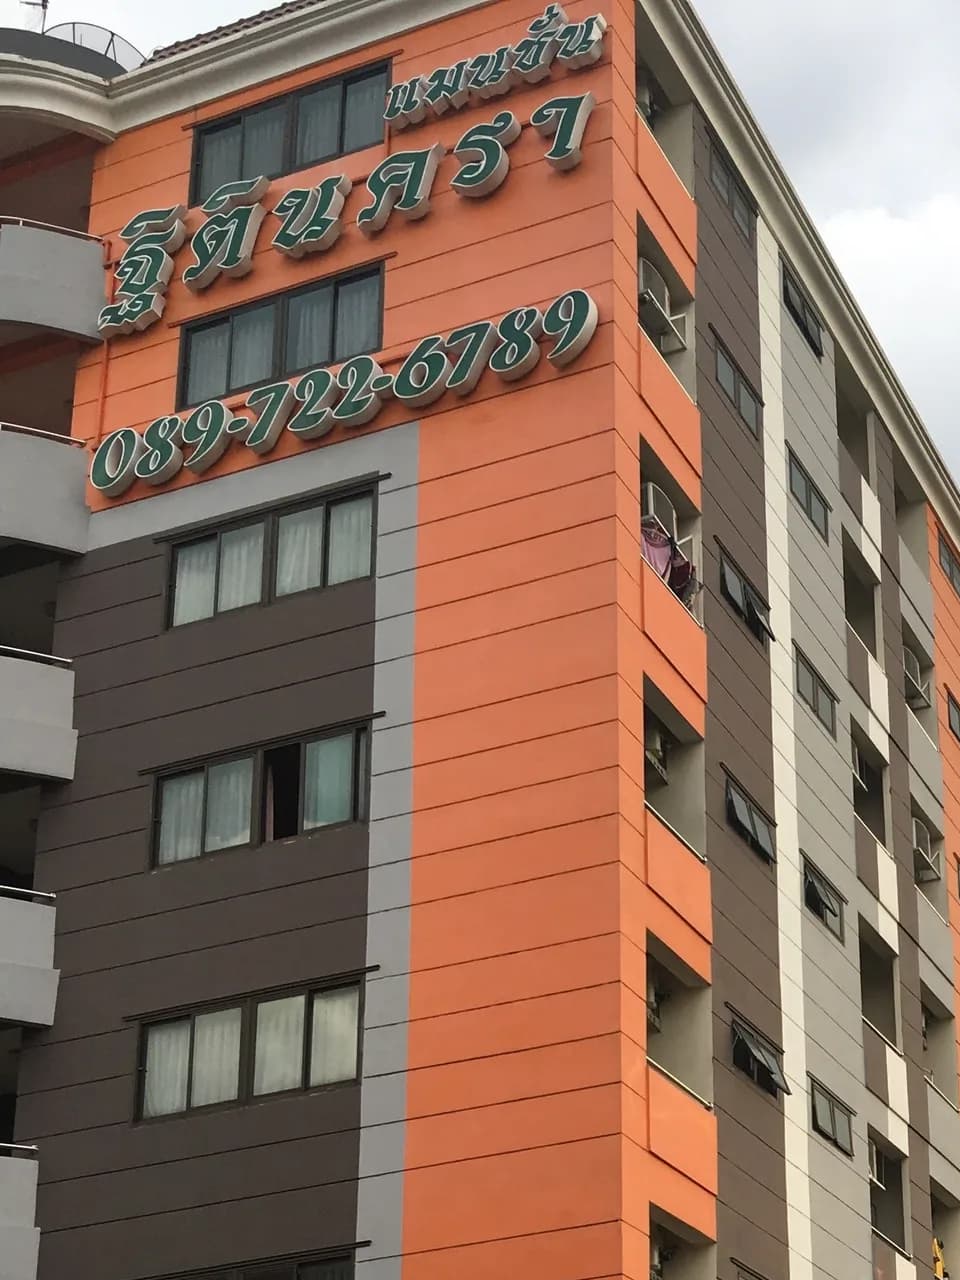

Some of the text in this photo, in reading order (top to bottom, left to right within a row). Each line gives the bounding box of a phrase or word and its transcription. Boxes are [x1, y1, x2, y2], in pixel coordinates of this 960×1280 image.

[383, 2, 607, 122] แมนชั่น
[90, 288, 598, 493] 089-722-6789
